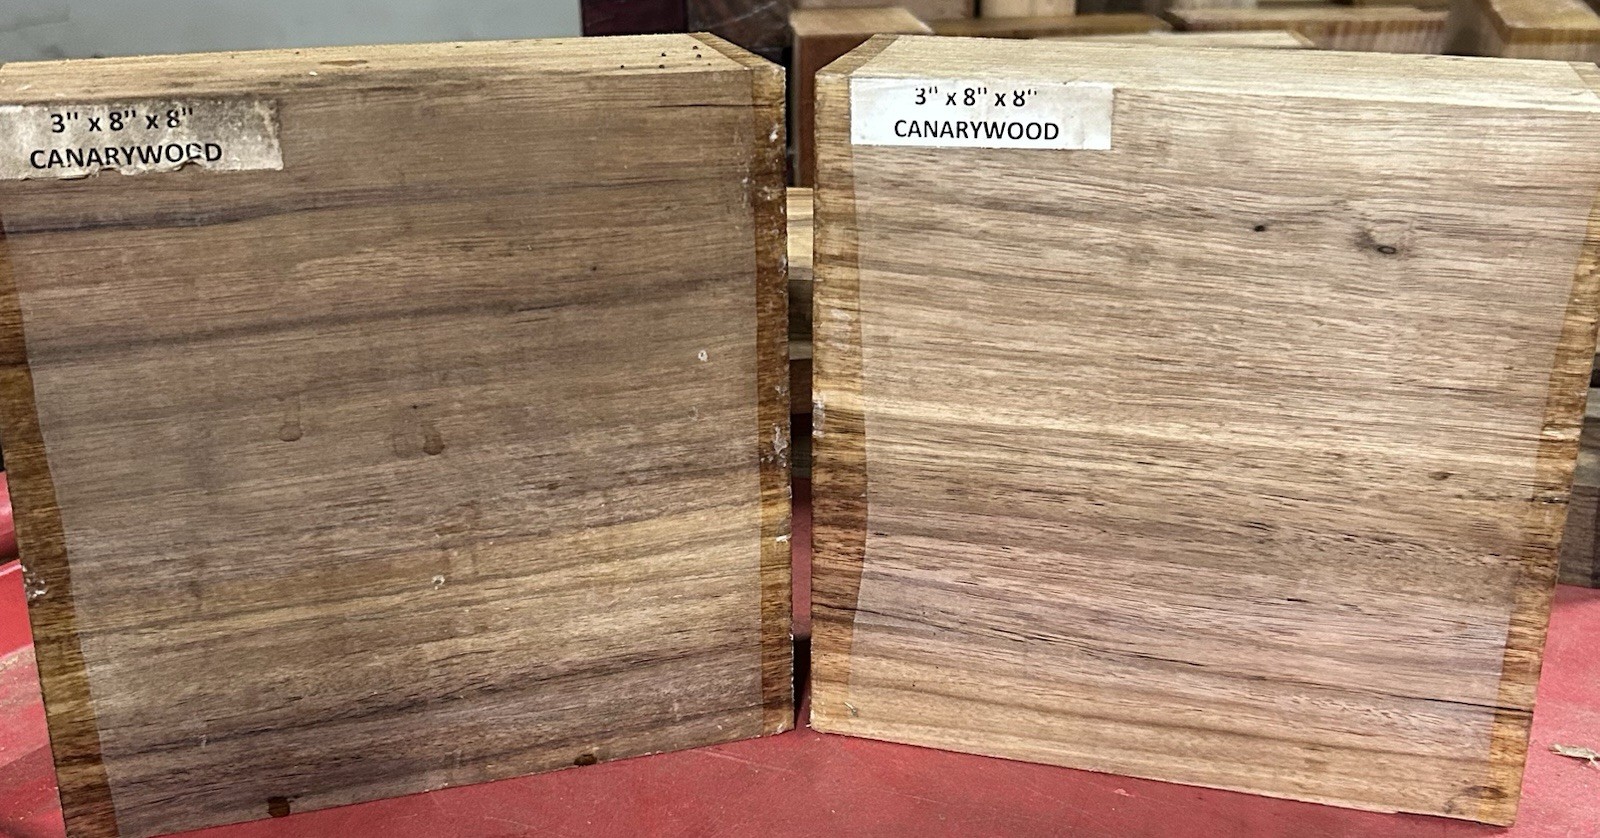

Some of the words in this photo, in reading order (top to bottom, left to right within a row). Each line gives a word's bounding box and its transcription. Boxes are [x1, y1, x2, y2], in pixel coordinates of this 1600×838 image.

[915, 86, 938, 105] 3"
[945, 92, 957, 106] x
[963, 87, 988, 106] 8"
[994, 93, 1007, 107] x
[50, 111, 79, 133] 3"
[88, 116, 102, 132] x
[109, 110, 137, 131] 8"
[145, 114, 159, 129] x
[166, 107, 194, 128] 8"
[894, 119, 1060, 140] CANARYWOOD
[30, 142, 222, 169] CANARYWOOD
